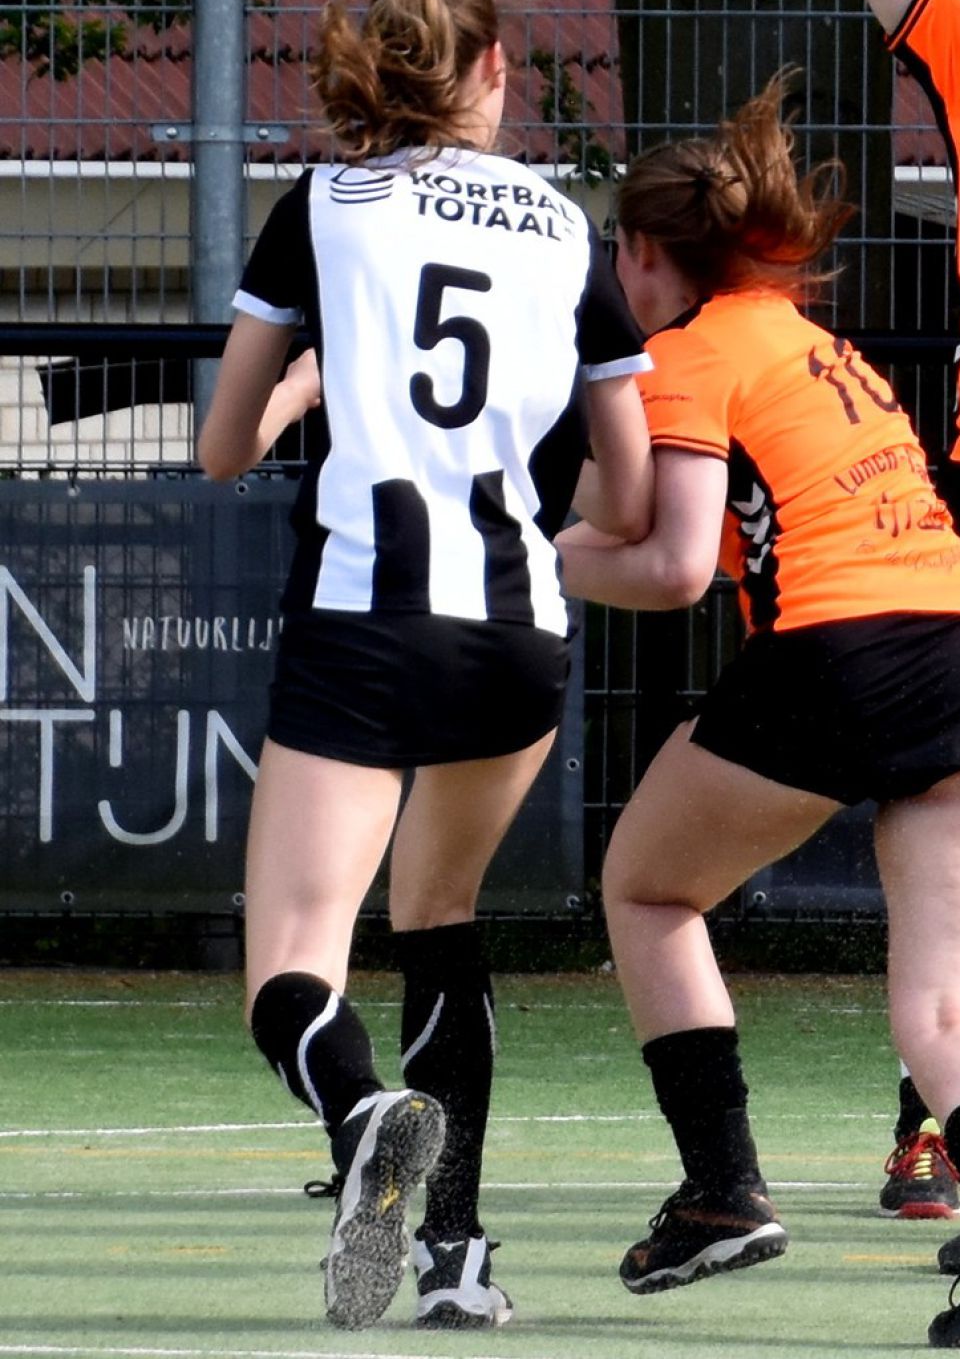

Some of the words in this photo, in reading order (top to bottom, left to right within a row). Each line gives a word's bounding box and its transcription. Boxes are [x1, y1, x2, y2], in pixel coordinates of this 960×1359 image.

[409, 170, 576, 225] KORFBAL
[411, 191, 562, 242] TOTAAL
[410, 262, 493, 430] 5
